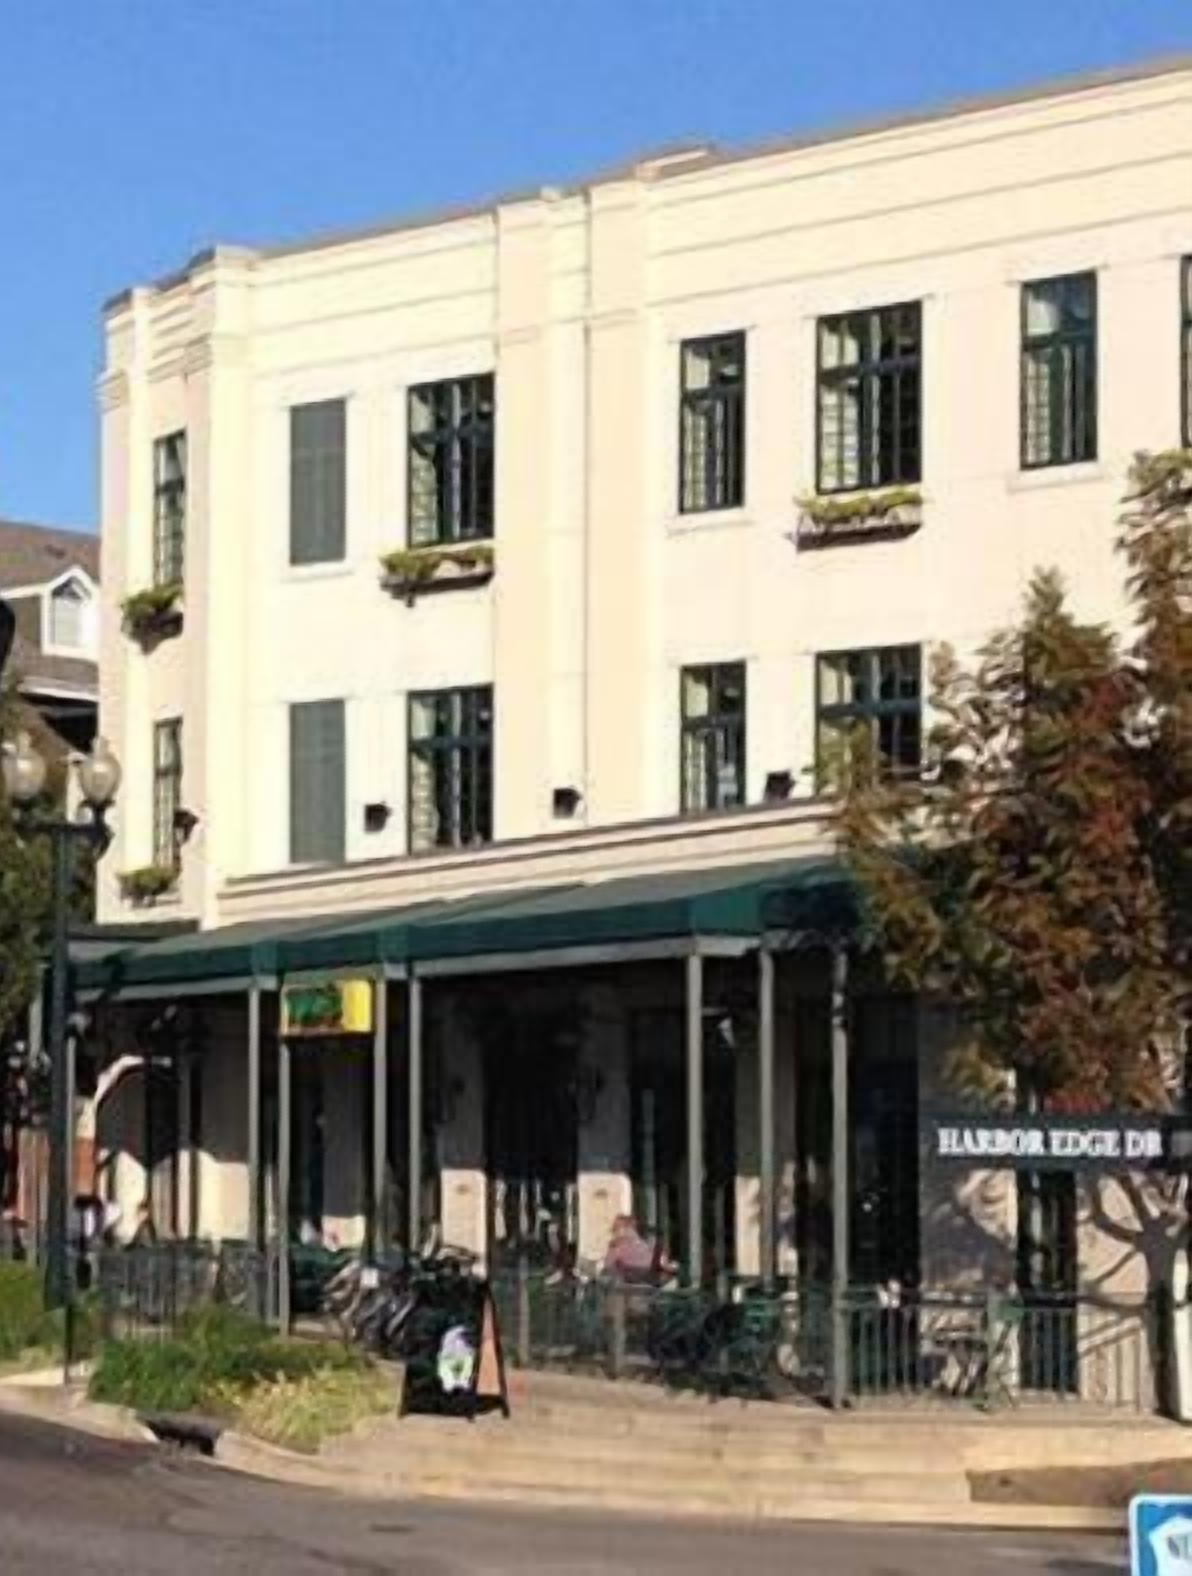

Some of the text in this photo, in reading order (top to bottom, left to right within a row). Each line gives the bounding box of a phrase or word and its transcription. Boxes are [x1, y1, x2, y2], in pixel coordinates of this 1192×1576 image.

[938, 1128, 1162, 1157] HARBOR EDGE DR
